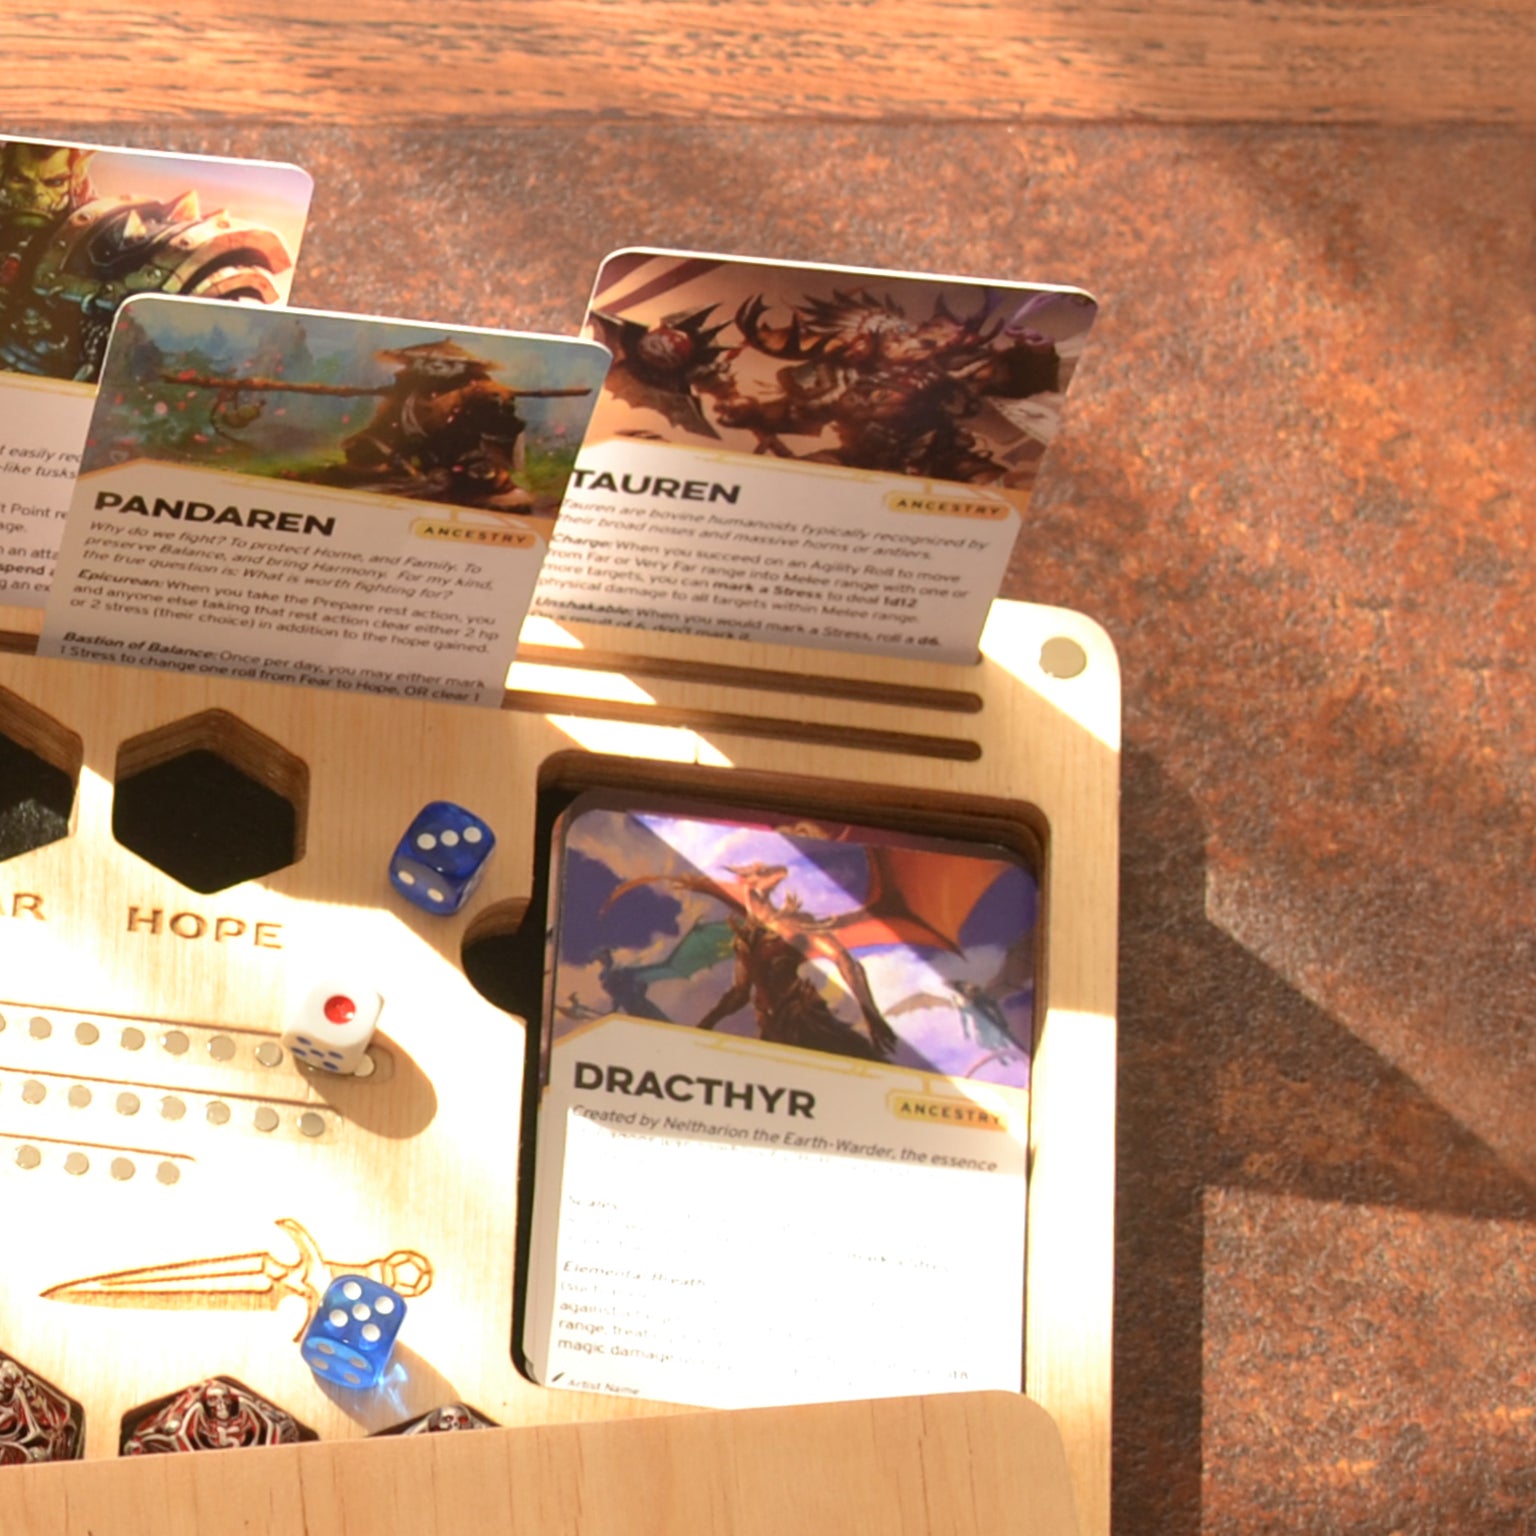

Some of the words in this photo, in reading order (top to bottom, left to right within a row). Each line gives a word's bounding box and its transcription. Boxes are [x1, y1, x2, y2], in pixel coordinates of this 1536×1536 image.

[571, 469, 741, 504] TAUREN
[897, 499, 1001, 516] ANCESTRY
[94, 491, 336, 537] PANDAREN
[423, 526, 528, 544] ANCESTRY
[127, 907, 282, 950] HOPE
[573, 1061, 816, 1119] DRACTHYR
[638, 1113, 660, 1130] by
[663, 1116, 749, 1139] Neltharion
[753, 1127, 780, 1144] the
[899, 1145, 928, 1163] the
[930, 1152, 997, 1173] essence
